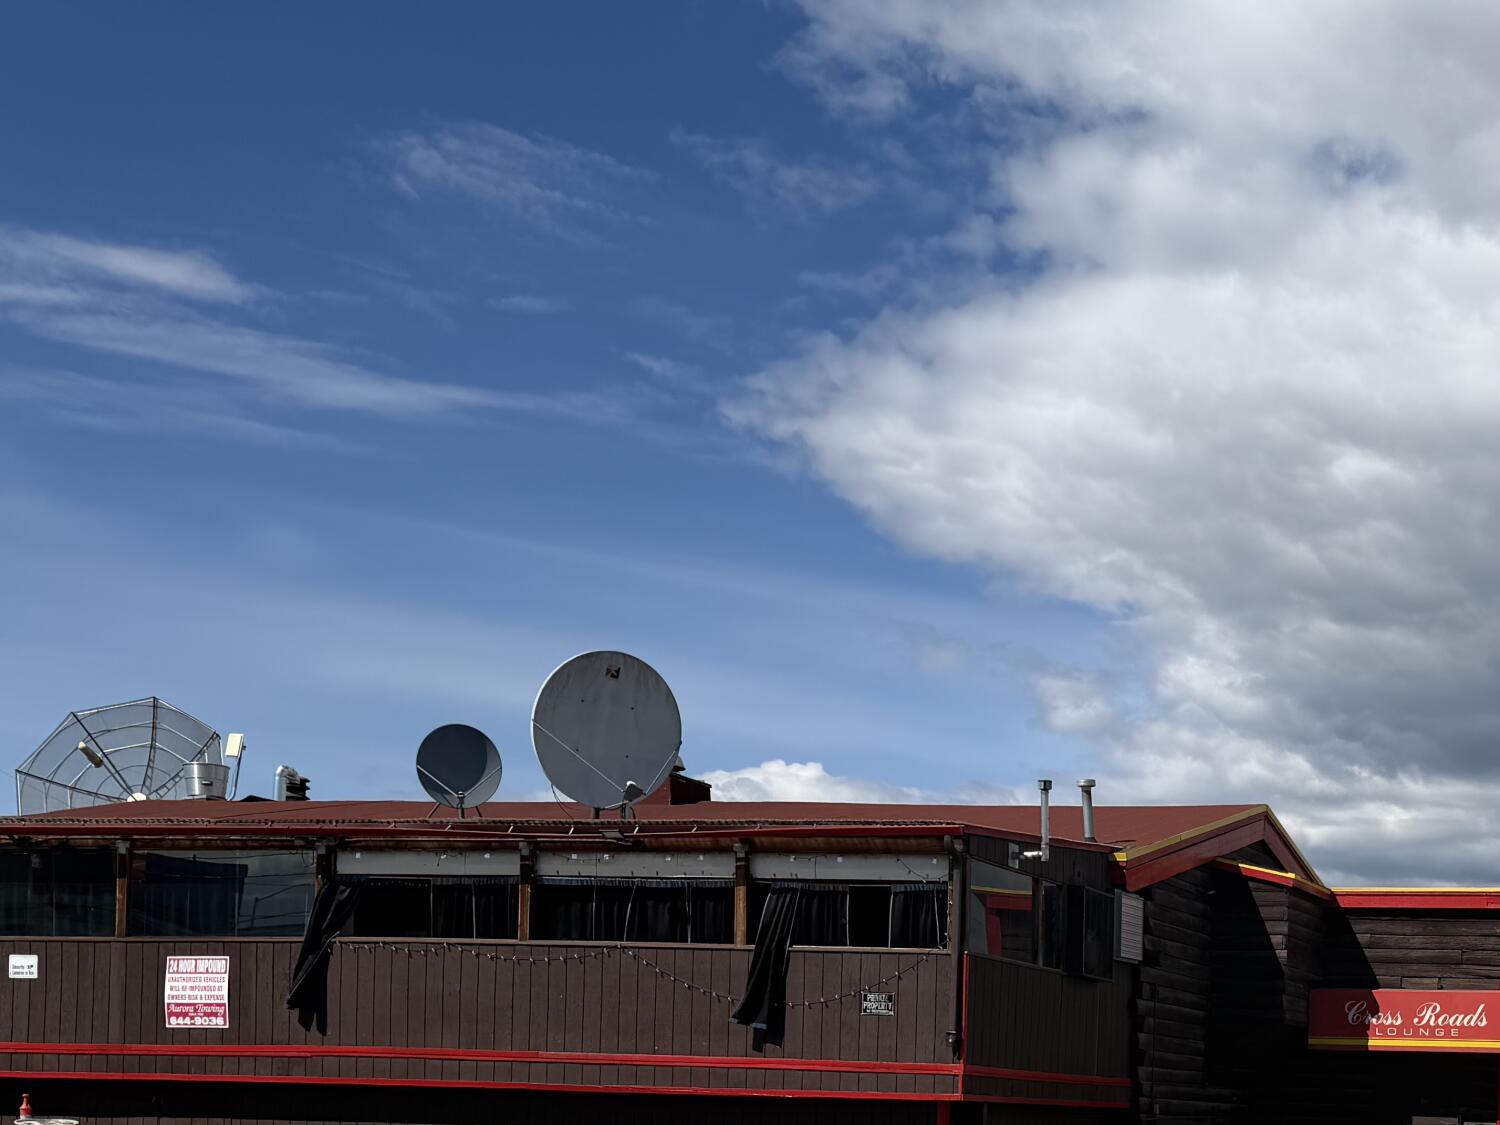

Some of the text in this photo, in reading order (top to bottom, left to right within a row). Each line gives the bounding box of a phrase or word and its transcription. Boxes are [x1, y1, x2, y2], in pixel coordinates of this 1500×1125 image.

[169, 960, 226, 973] 24 HOUR IMPOUND
[168, 1003, 194, 1013] Aurora
[195, 1003, 225, 1016] Towing
[1345, 1000, 1488, 1027] Cross Roads
[169, 1016, 225, 1026] 644-9036
[1375, 1027, 1459, 1037] LOUNGE
